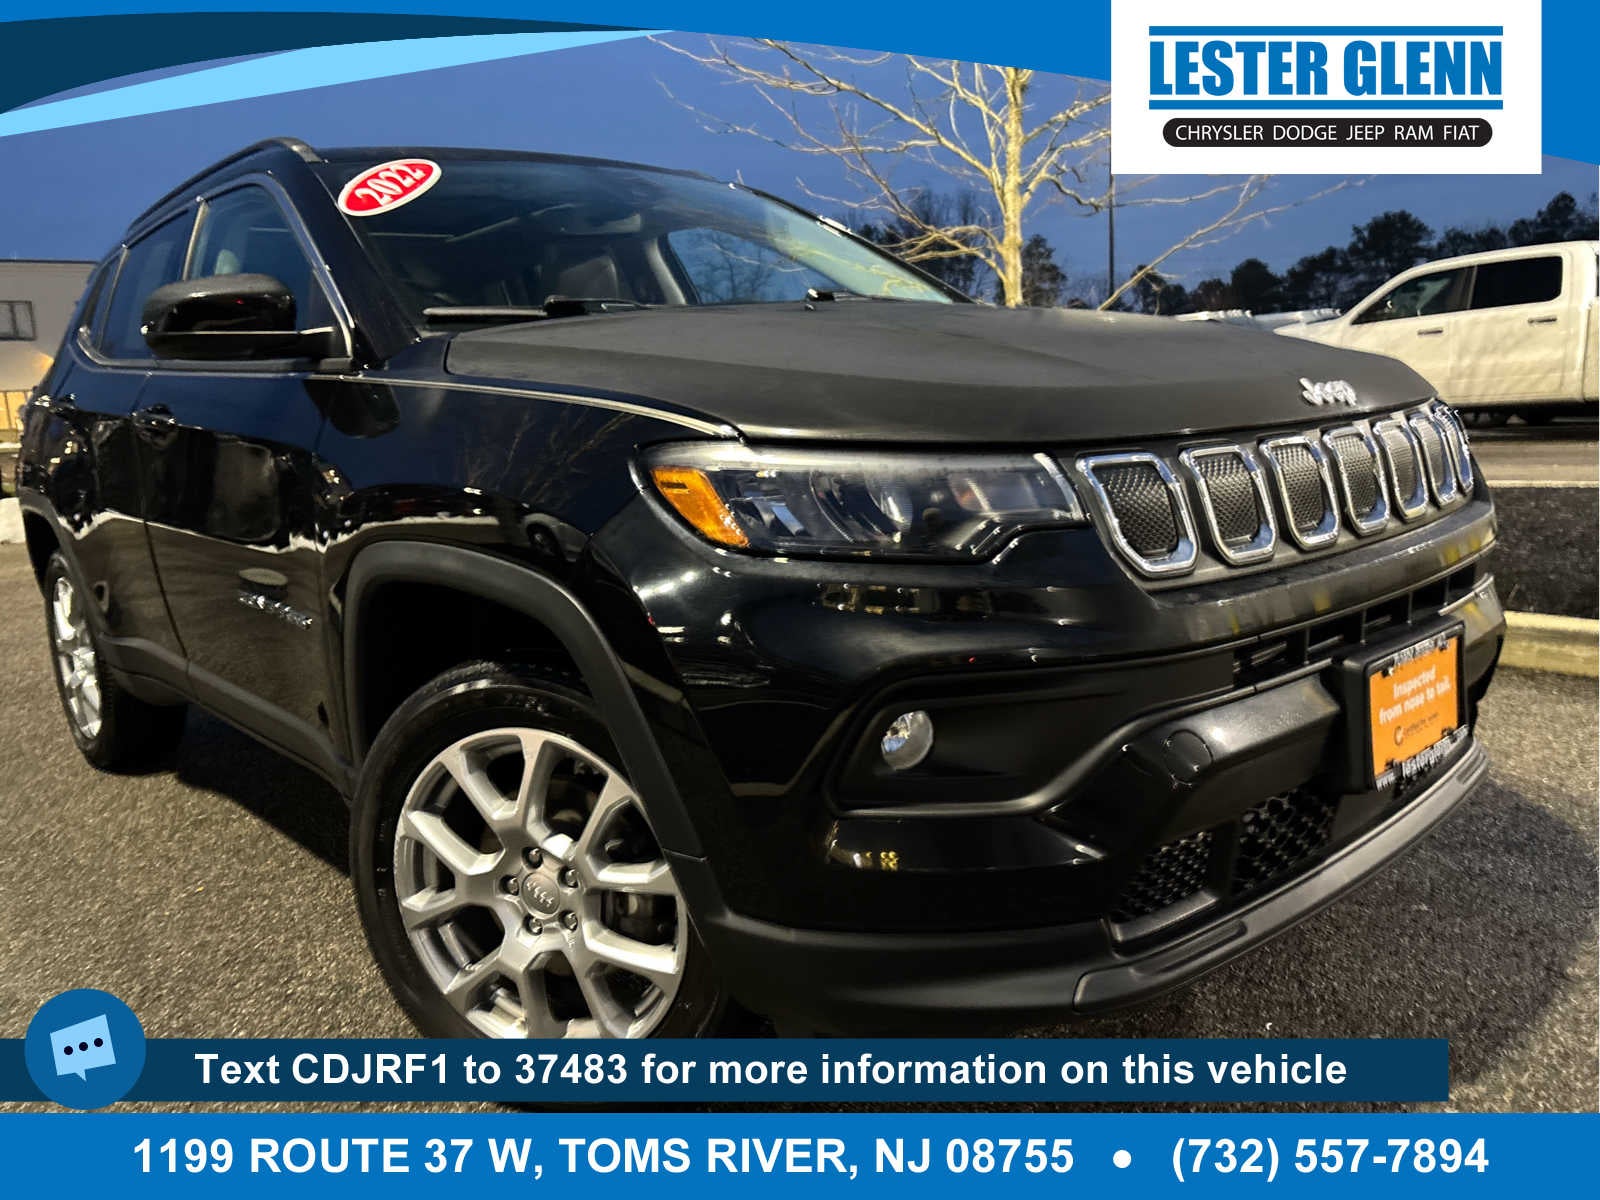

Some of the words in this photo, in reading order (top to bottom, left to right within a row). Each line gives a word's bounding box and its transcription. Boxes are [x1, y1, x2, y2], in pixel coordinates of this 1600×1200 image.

[354, 164, 426, 206] 2022
[1299, 377, 1357, 406] Jeep
[1393, 664, 1436, 699] Inspected
[1379, 702, 1402, 725] from
[1404, 694, 1425, 713] nose
[1426, 686, 1435, 700] to
